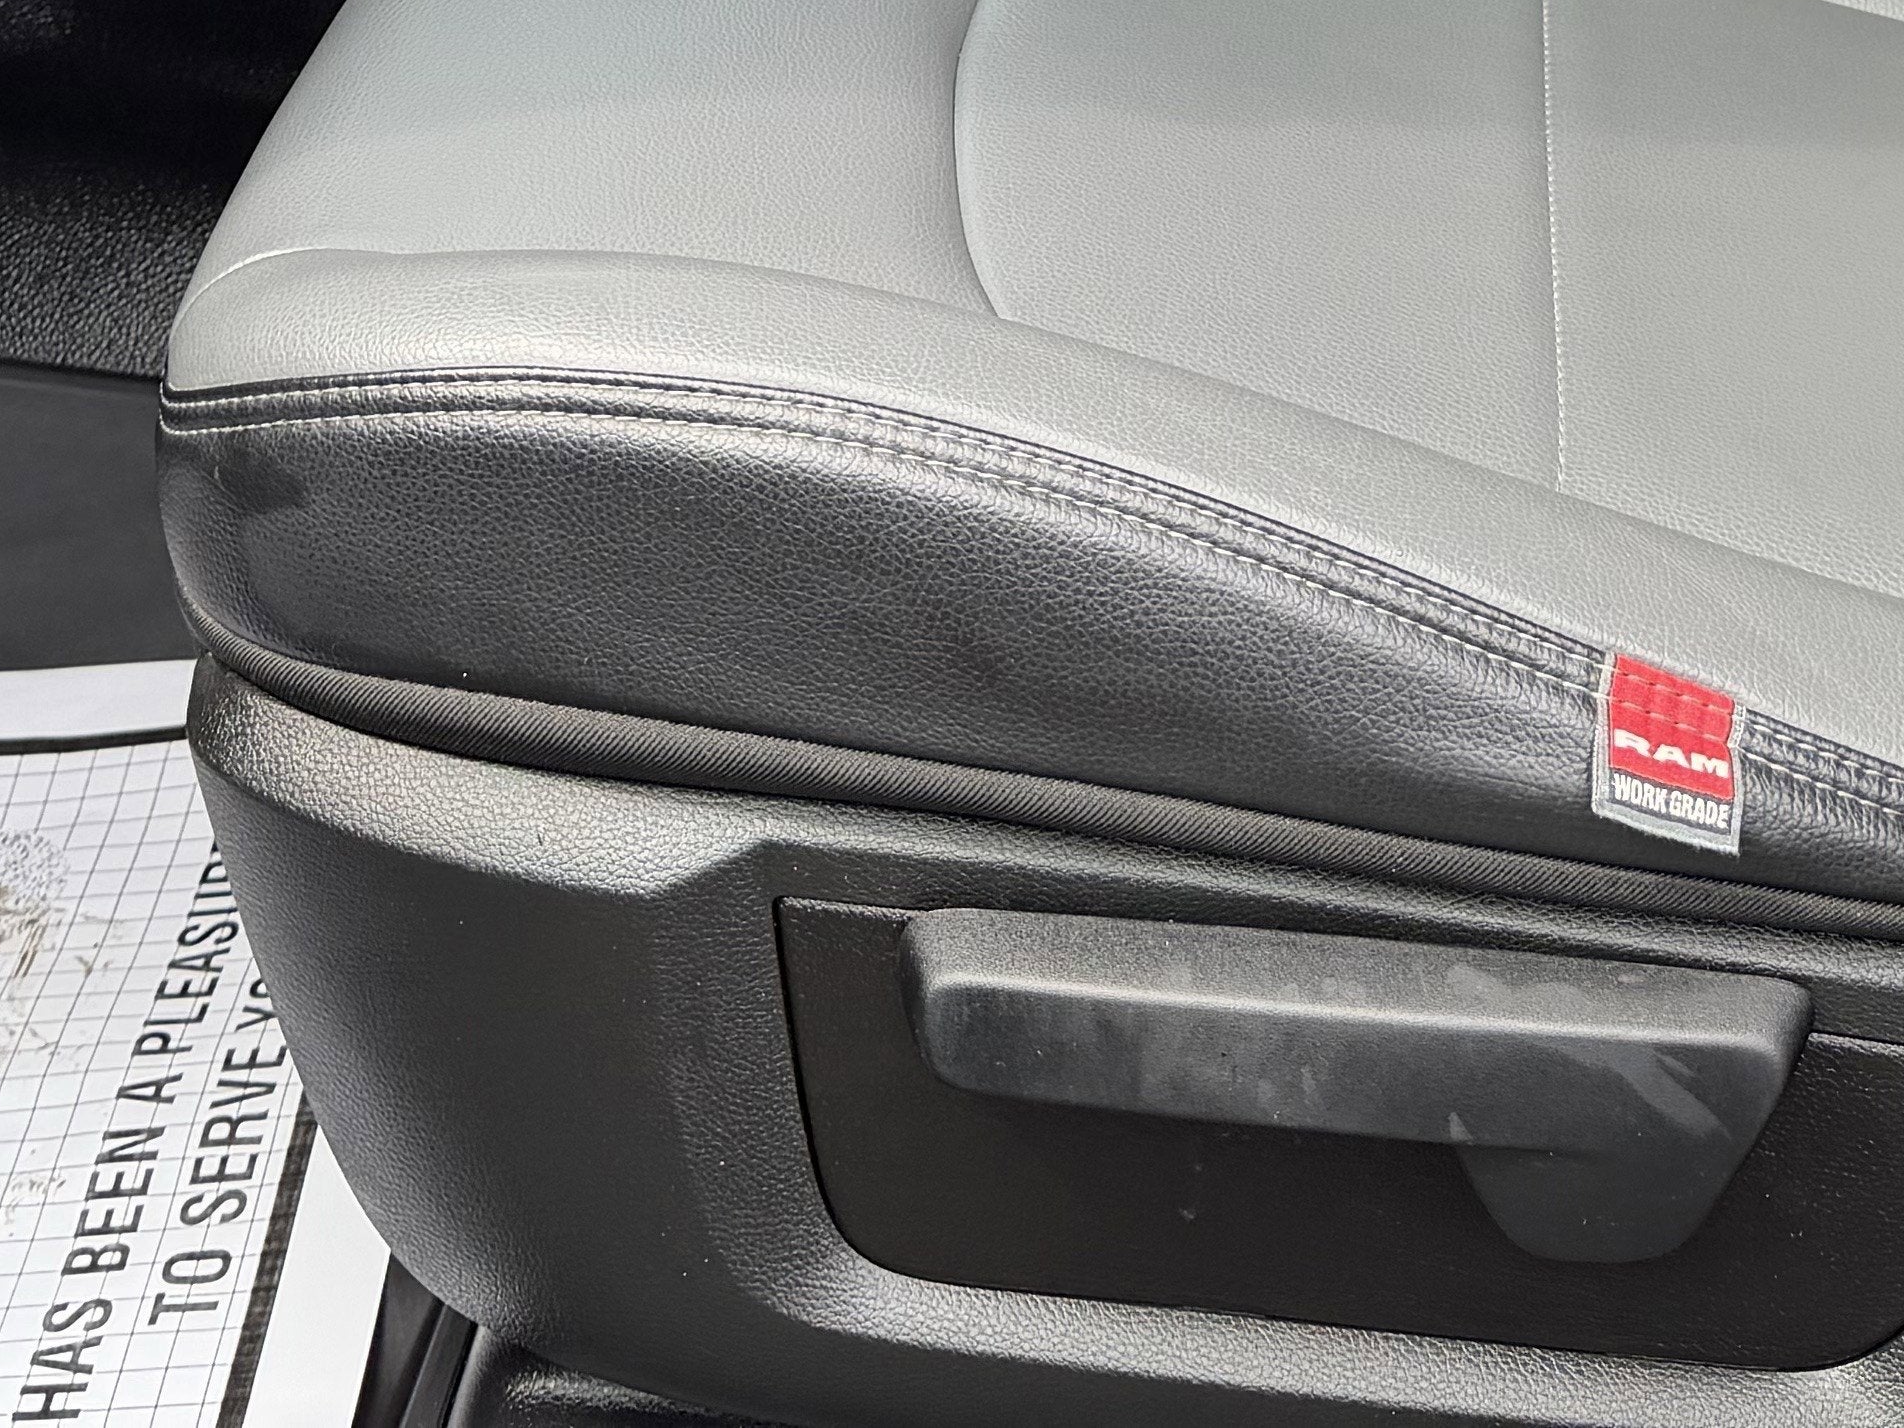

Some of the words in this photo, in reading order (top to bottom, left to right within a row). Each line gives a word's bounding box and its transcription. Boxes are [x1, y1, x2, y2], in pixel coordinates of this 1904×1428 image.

[1613, 729, 1728, 779] RAM
[1613, 773, 1668, 814] WORK
[1670, 790, 1730, 829] GRADE
[133, 838, 240, 1059] PLEASUR
[116, 1071, 185, 1105] A
[180, 1042, 289, 1226] SERVE
[61, 1124, 166, 1278] BEEN
[149, 1249, 234, 1326] TO
[11, 1298, 114, 1423] HAS
